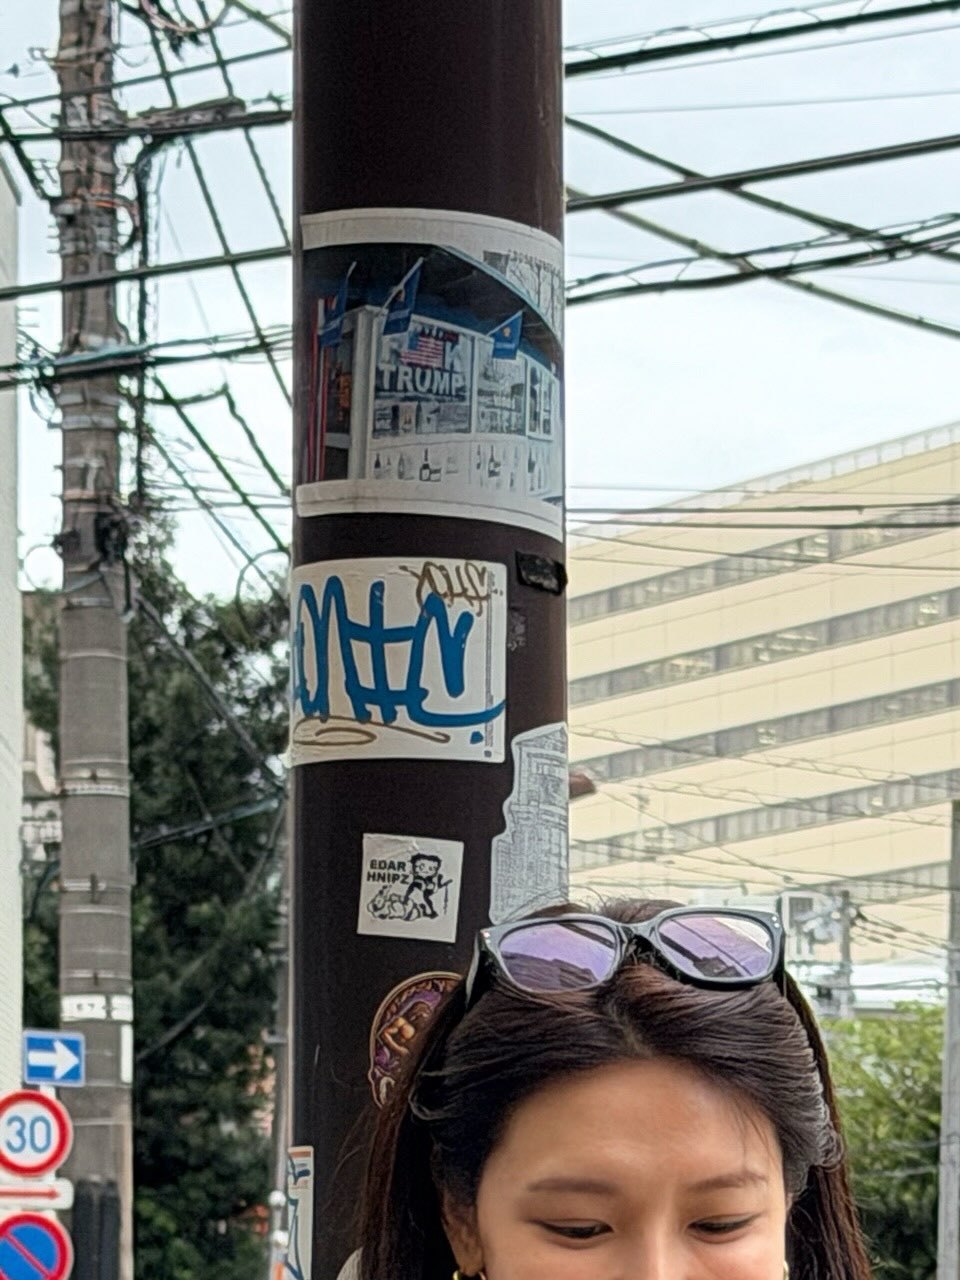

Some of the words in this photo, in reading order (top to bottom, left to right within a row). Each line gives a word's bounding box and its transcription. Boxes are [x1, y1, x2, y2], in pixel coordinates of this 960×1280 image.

[378, 363, 466, 396] TRUMP
[369, 859, 407, 872] EDAR
[366, 871, 411, 885] HNIPZ
[5, 1115, 52, 1153] 30
